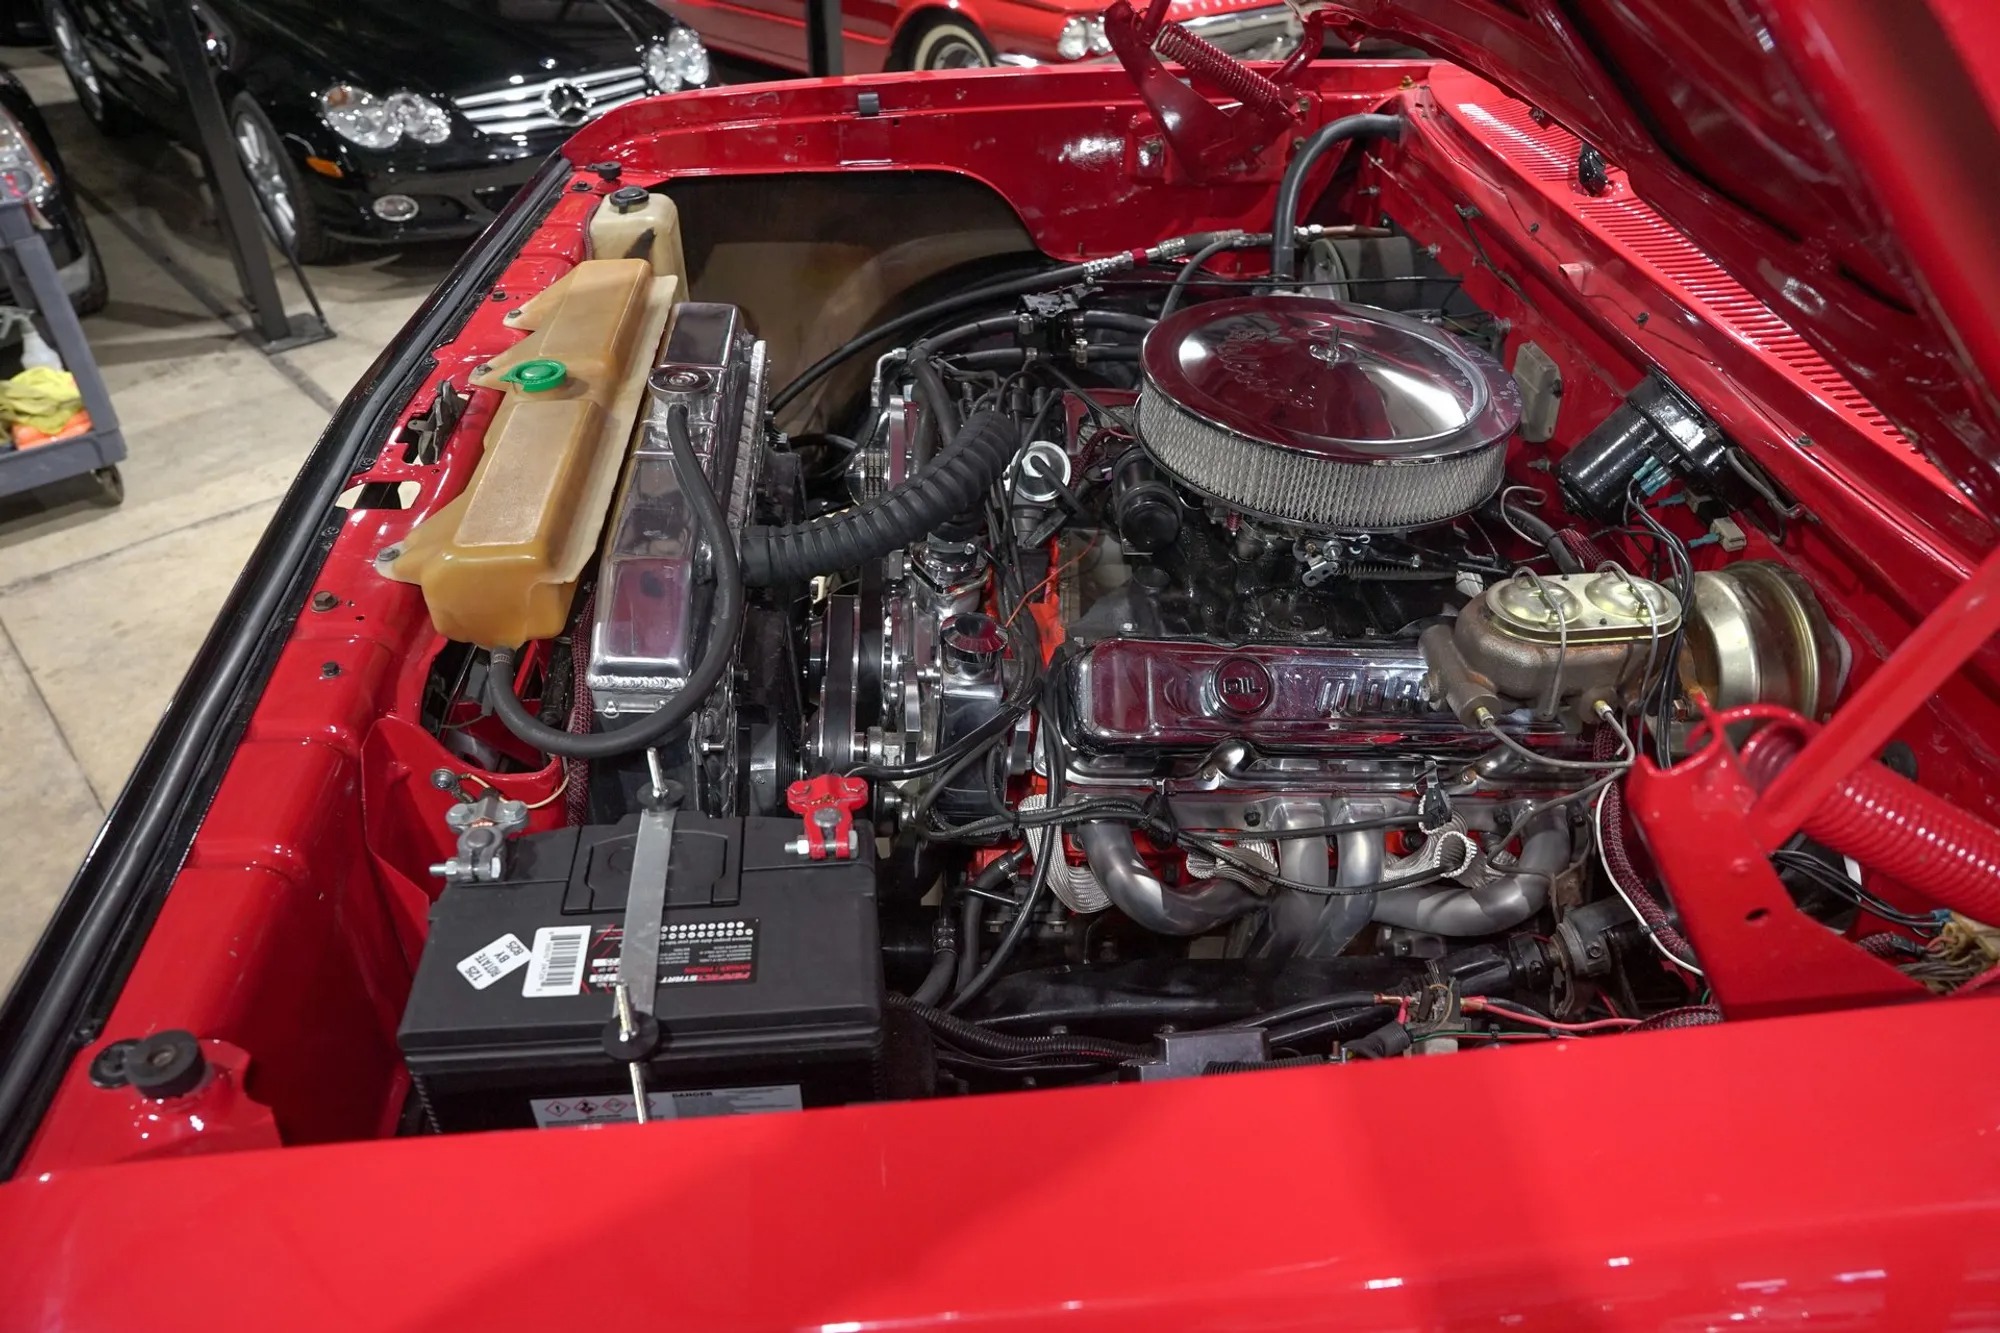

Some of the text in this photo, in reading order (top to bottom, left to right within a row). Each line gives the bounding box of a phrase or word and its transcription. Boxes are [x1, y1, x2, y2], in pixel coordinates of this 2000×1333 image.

[1222, 677, 1263, 695] OIL
[474, 953, 502, 978] ROTATE
[494, 951, 510, 964] BY
[464, 965, 484, 981] 125
